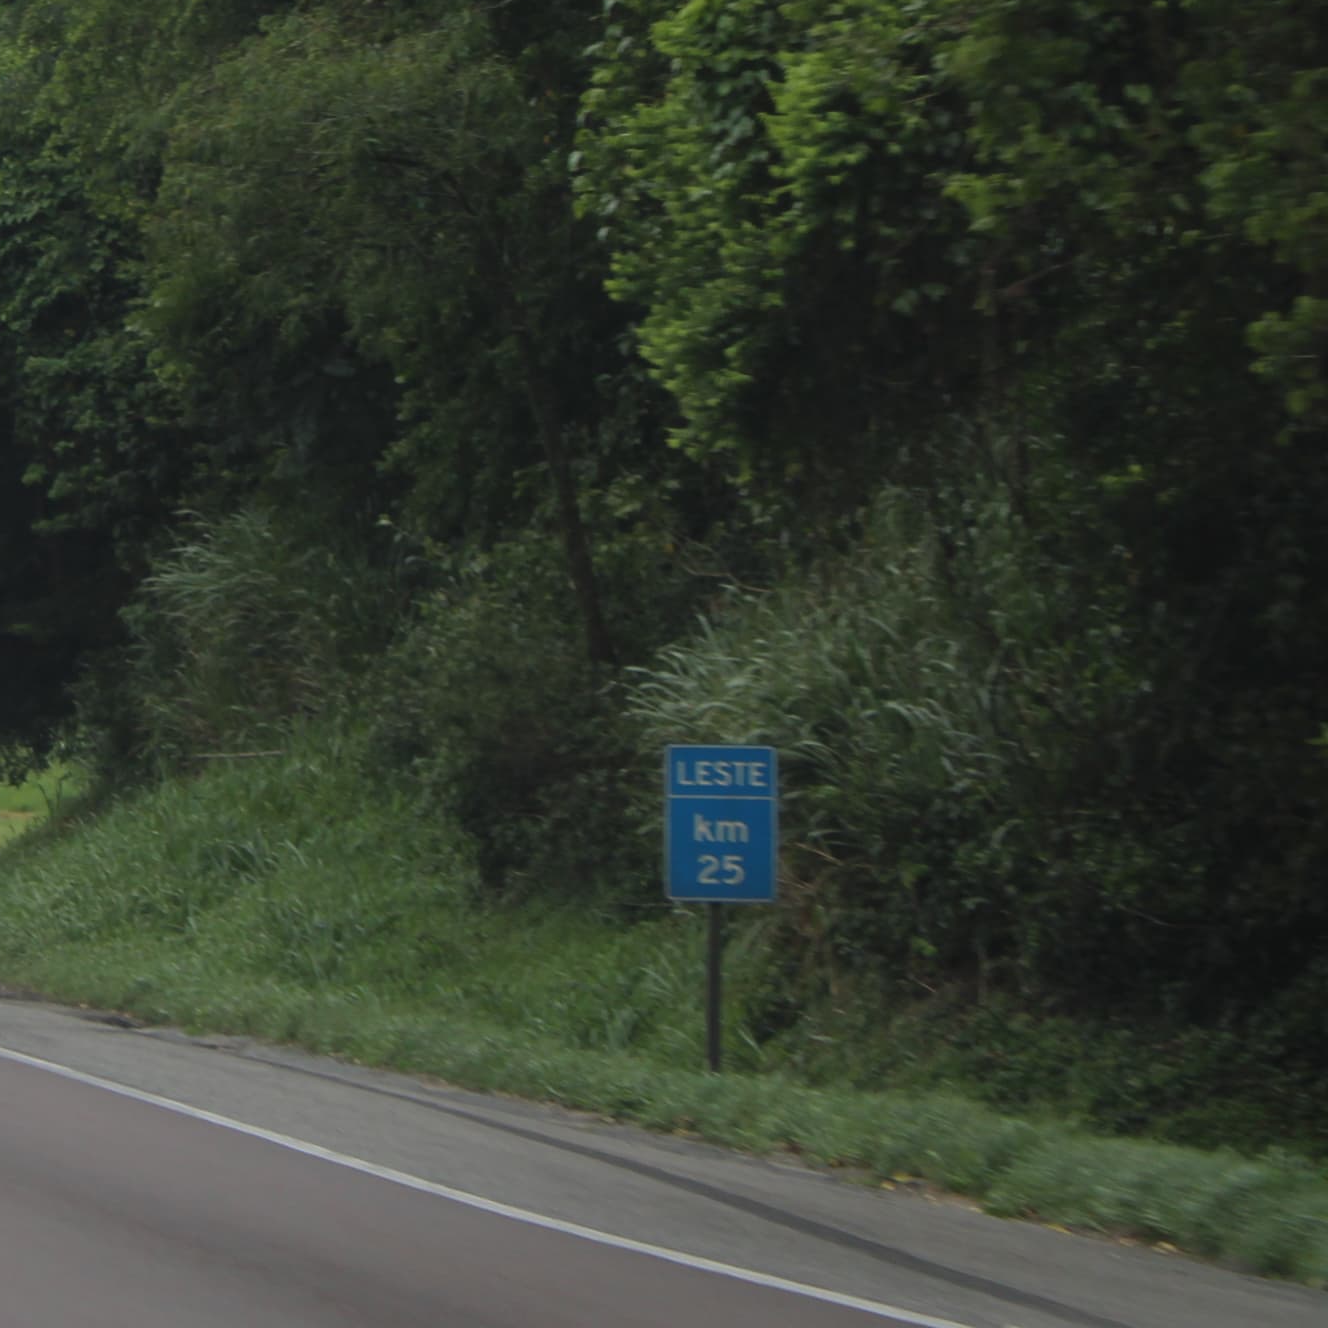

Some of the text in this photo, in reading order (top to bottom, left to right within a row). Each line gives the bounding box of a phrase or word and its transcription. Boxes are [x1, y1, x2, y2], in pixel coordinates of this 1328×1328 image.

[676, 761, 768, 786] LESTE
[694, 813, 749, 842] km
[697, 855, 745, 884] 25
